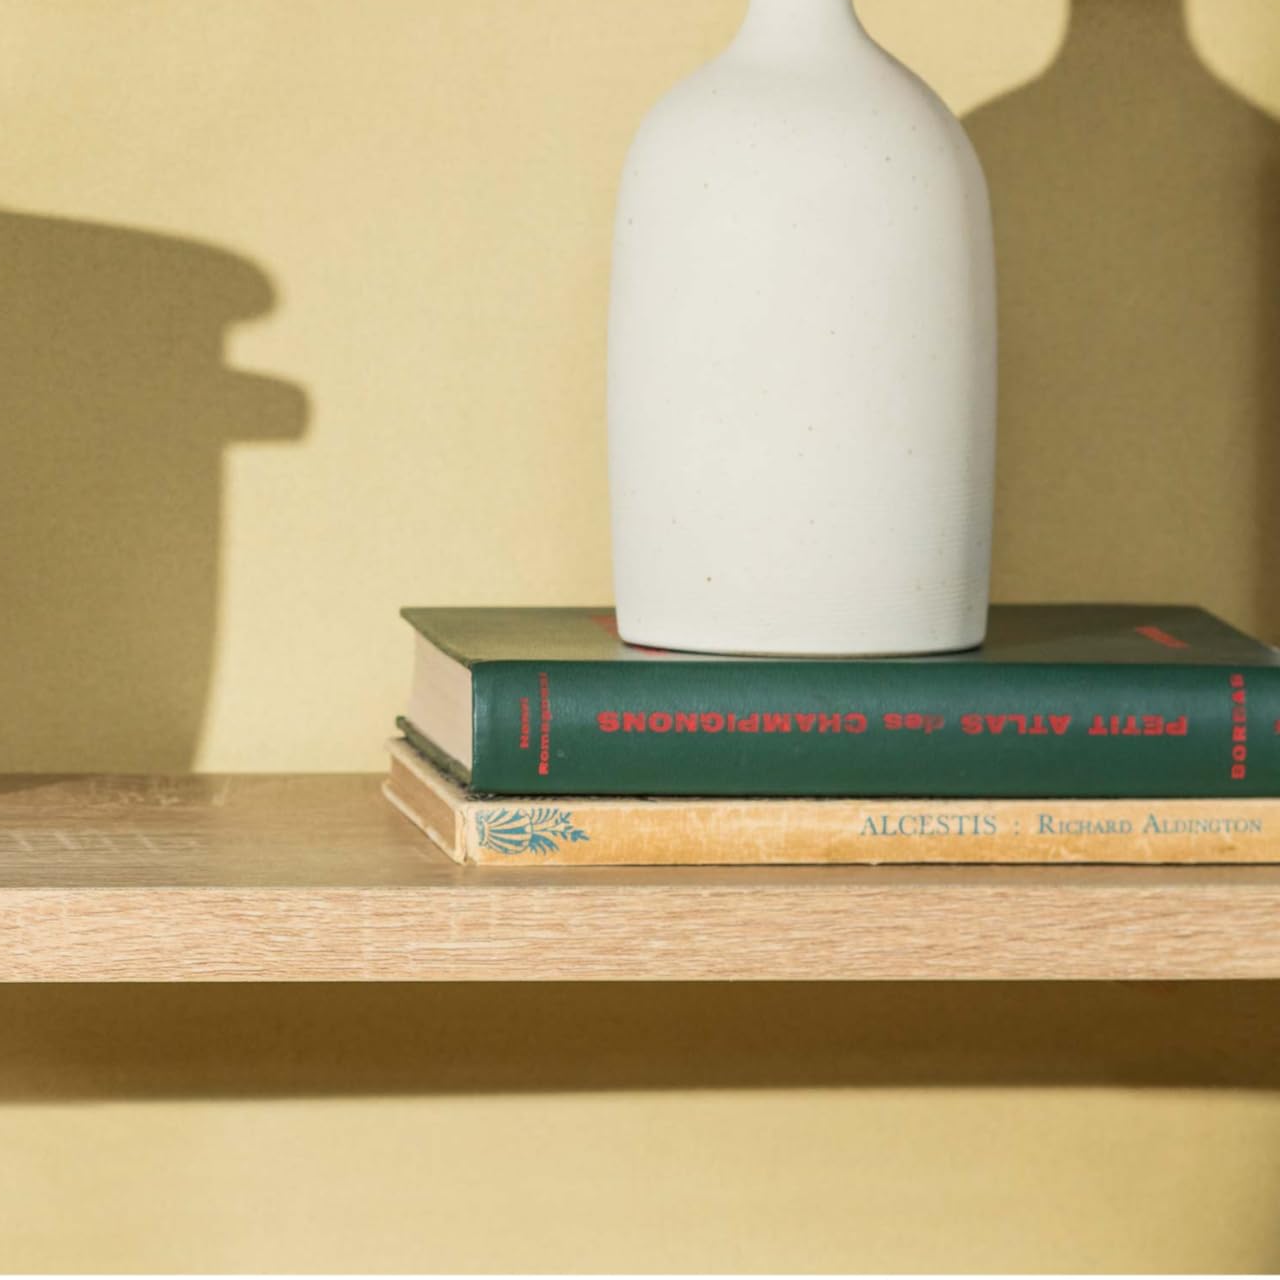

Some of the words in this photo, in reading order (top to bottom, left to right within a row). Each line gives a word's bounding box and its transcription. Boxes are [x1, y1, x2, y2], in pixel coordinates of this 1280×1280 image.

[596, 710, 868, 734] CHAMPIGNONS
[883, 712, 945, 735] des
[961, 713, 1072, 736] ATLAS
[1087, 714, 1188, 737] PETIT
[1231, 674, 1247, 780] BORDAS
[859, 814, 999, 837] ALCESTIS
